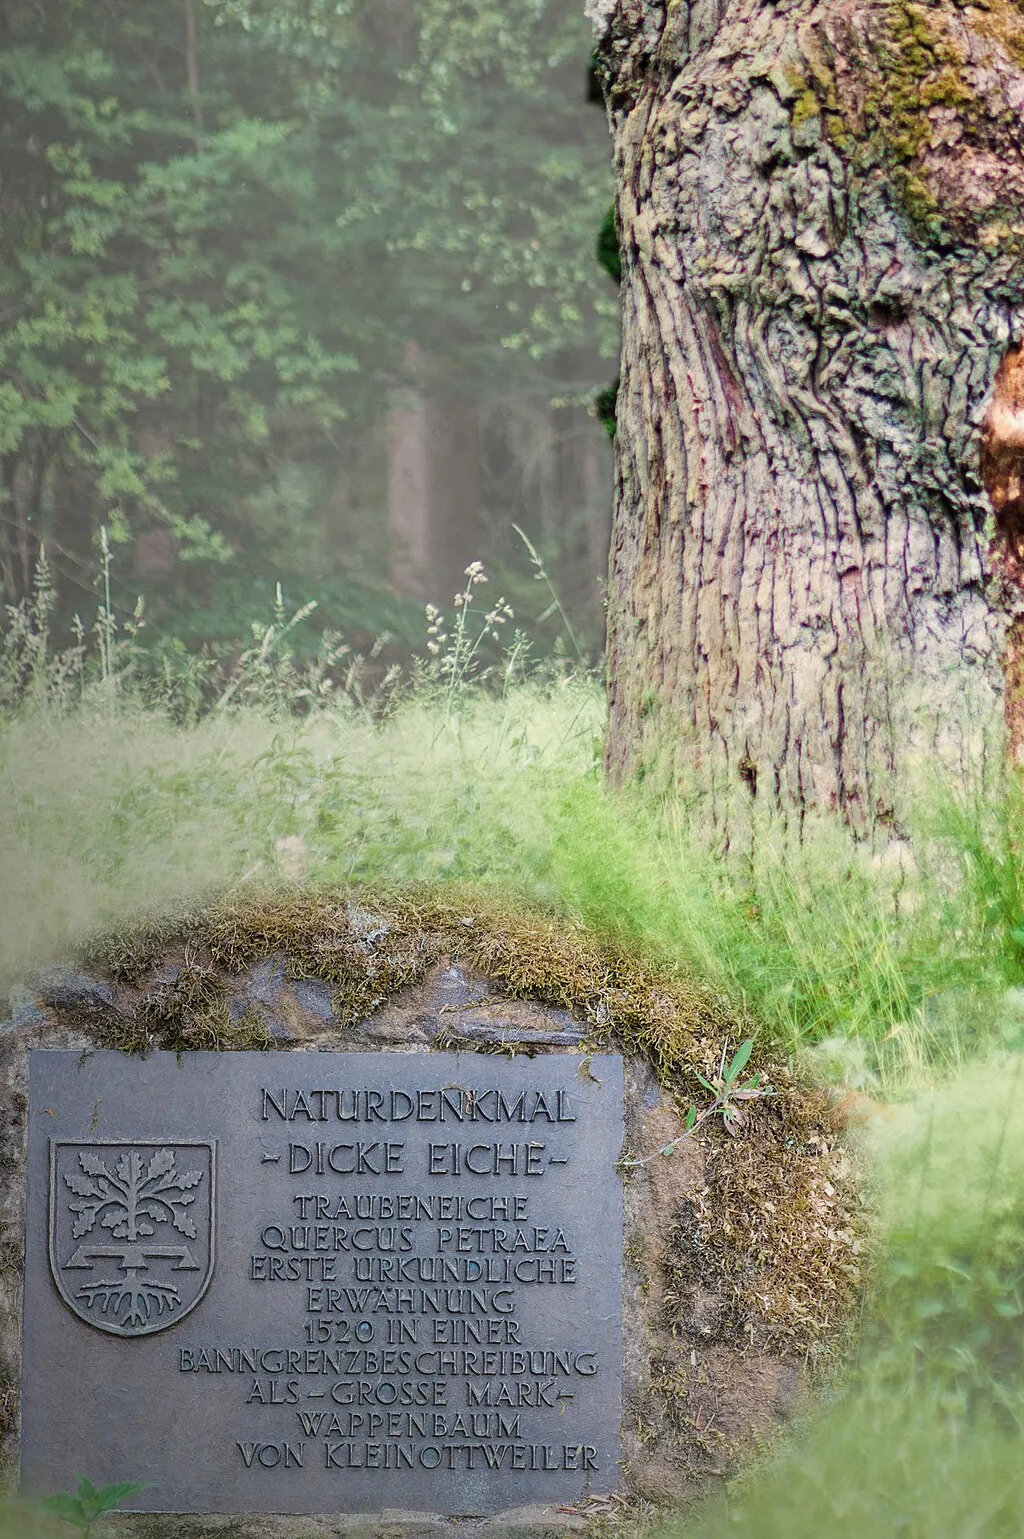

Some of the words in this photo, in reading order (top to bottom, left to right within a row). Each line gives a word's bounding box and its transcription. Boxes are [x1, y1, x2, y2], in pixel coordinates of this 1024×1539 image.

[261, 1087, 576, 1123] NATURDENKMAL
[293, 1194, 530, 1222] TRAUBENEICHE
[261, 1225, 413, 1253] QUERCUS
[437, 1227, 572, 1254] PETRAEA
[250, 1256, 338, 1282] ERSTE
[356, 1257, 577, 1284] URKUNDLICHE
[306, 1285, 516, 1314] ERWÄHNUNG
[304, 1319, 374, 1344] 1520
[387, 1319, 418, 1344] IN
[434, 1319, 523, 1345] EINER
[178, 1348, 600, 1376] BANNGRENZBESCHREIBUNG
[299, 1411, 522, 1439] WAPPENBAUM
[236, 1442, 305, 1470] VON
[325, 1442, 600, 1472] KLEINOTTWEILER
